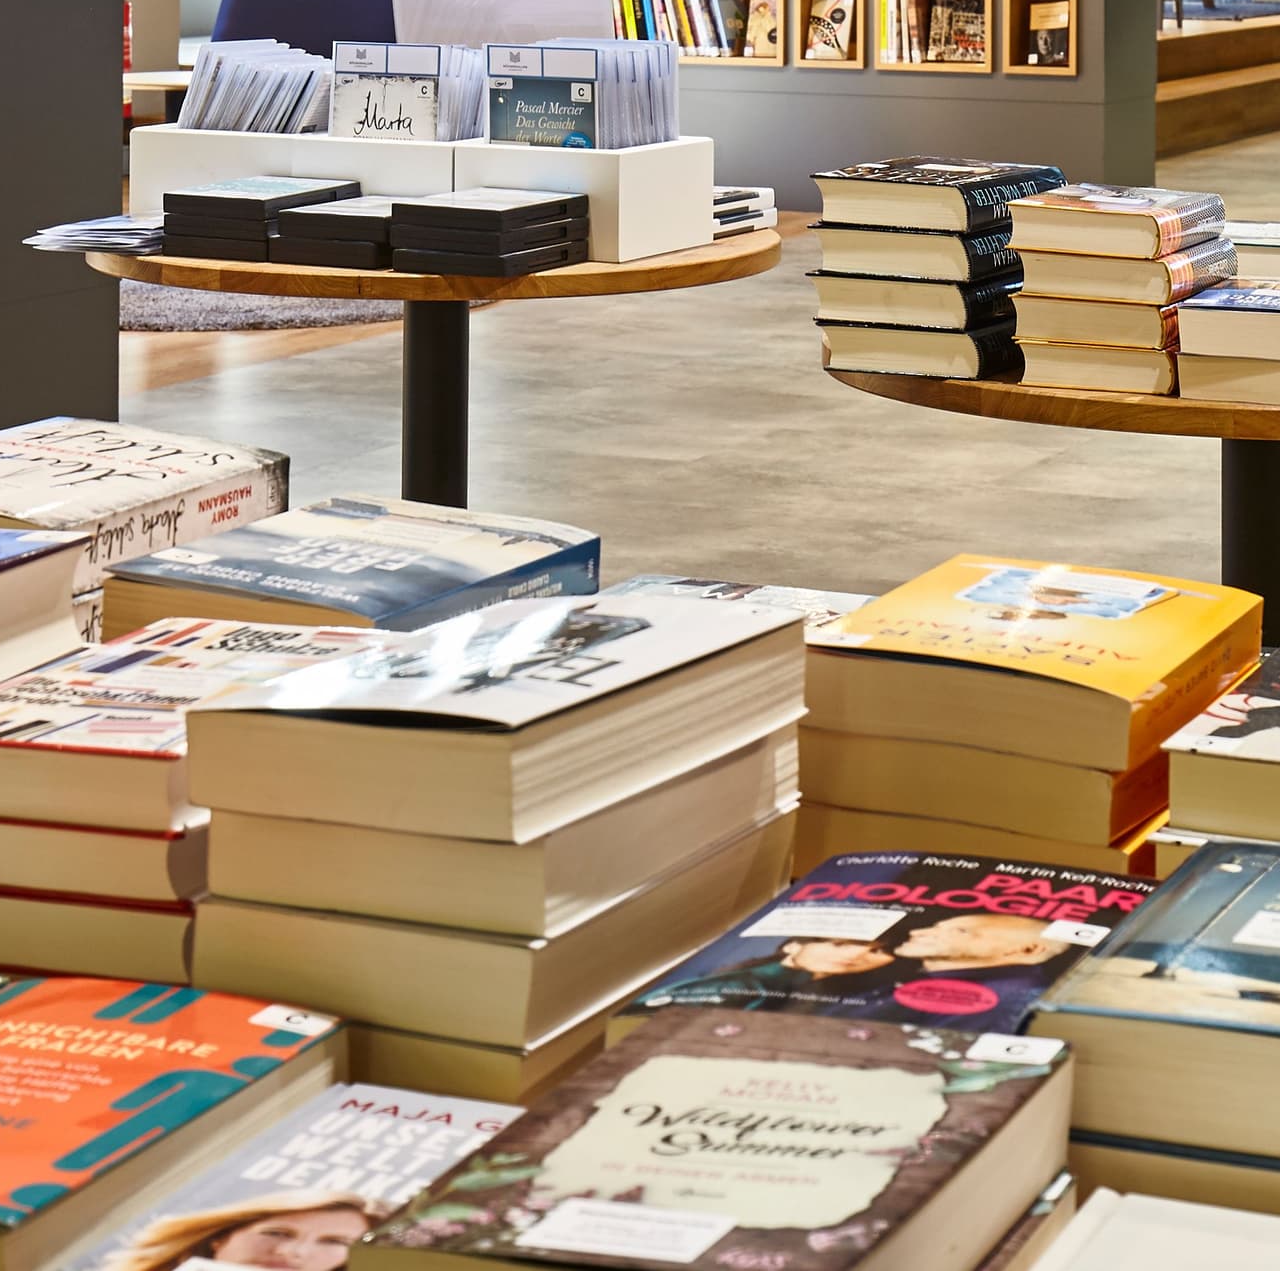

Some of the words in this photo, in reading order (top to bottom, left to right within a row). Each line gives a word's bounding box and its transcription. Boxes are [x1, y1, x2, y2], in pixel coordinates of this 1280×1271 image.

[577, 87, 586, 98] C
[353, 90, 415, 136] Marta
[515, 101, 546, 114] Pascal
[548, 102, 585, 116] Mercier
[515, 116, 536, 129] Das
[538, 117, 576, 131] Gewicht
[515, 130, 532, 142] der
[534, 131, 562, 144] Worte
[198, 484, 252, 513] HAUSMANN
[140, 497, 187, 548] Marta
[211, 504, 240, 526] ROMY
[205, 635, 343, 658] Schulze
[835, 854, 920, 870] Charlotte
[922, 855, 982, 871] Roche
[994, 862, 1056, 880] Martin
[789, 883, 1094, 924] DIOLOGIE
[285, 1014, 309, 1026] C
[1003, 1043, 1030, 1056] C
[339, 1098, 455, 1125] MAJA
[623, 1103, 890, 1141] Wildflower
[278, 1132, 445, 1175] WELT
[650, 1129, 860, 1159] Summer
